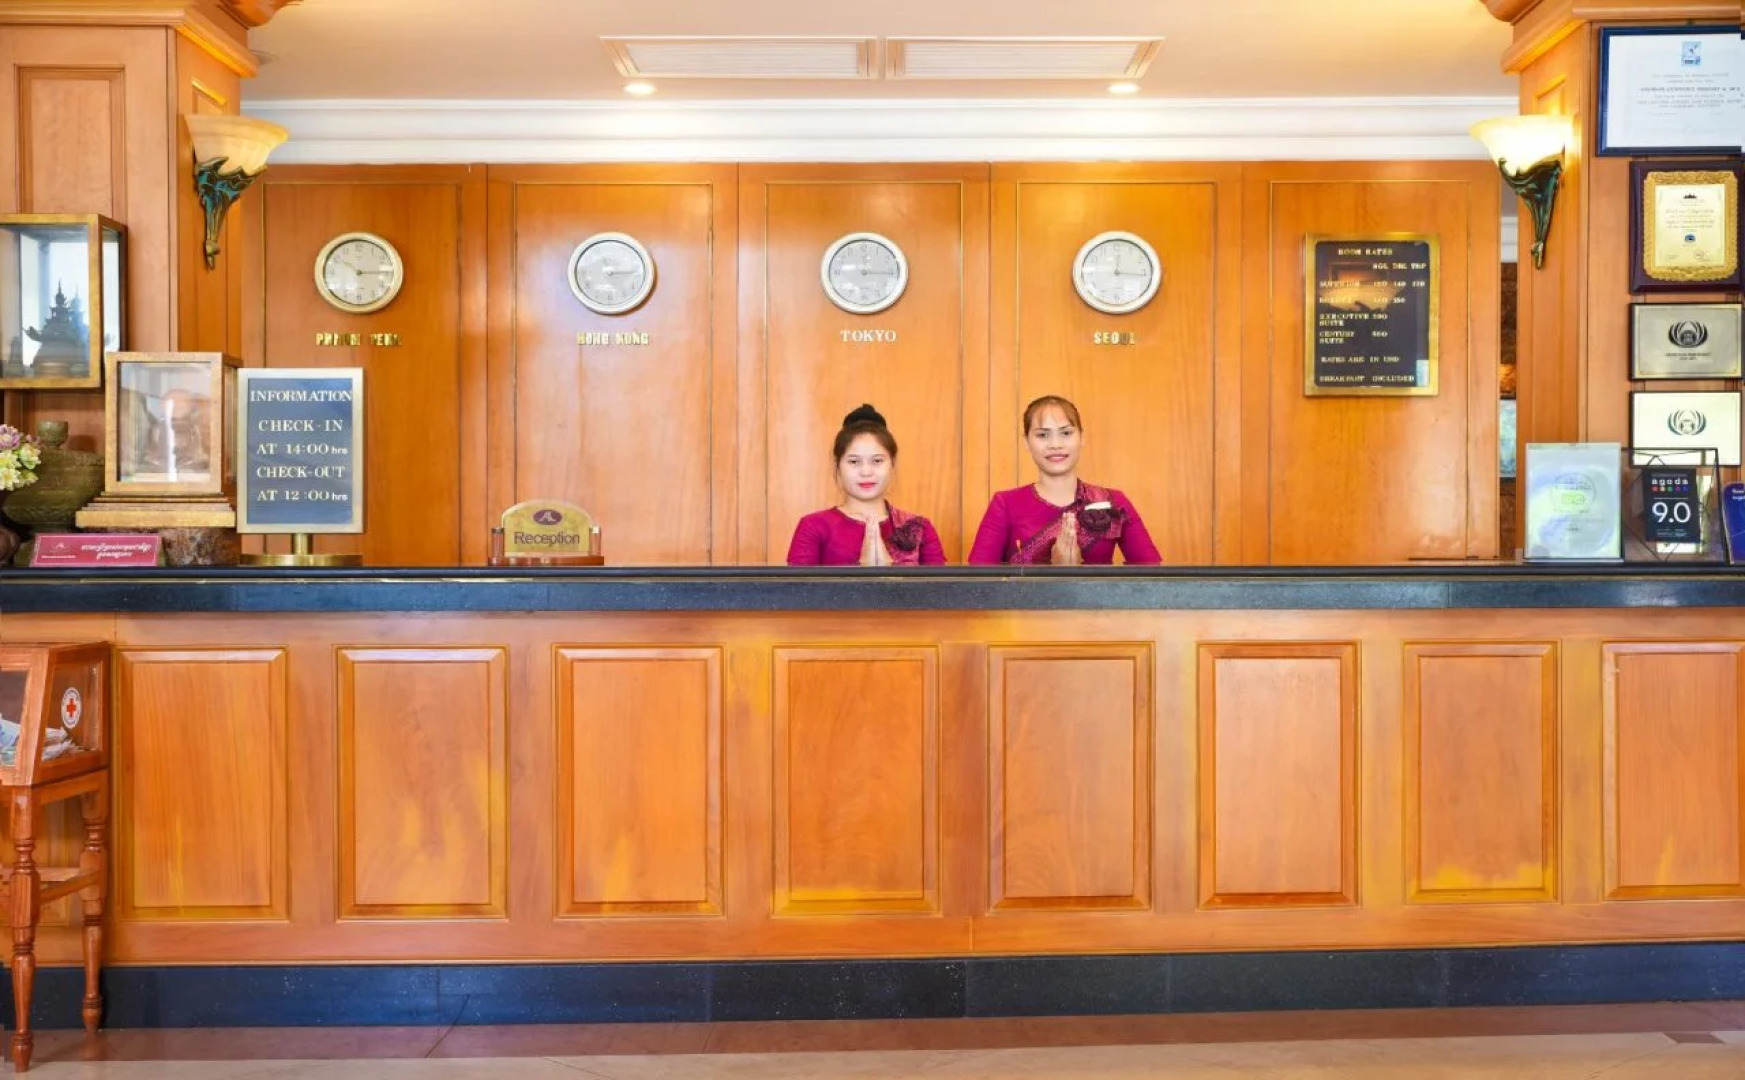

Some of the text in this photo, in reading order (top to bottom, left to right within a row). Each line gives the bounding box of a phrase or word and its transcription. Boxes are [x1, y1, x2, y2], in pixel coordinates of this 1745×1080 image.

[840, 329, 897, 342] TOKYO
[250, 390, 353, 402] INFORMATION
[257, 442, 278, 455] AT
[330, 445, 348, 455] hrs
[256, 465, 346, 478] CHECK-OUT
[1651, 478, 1689, 486] agoda
[257, 490, 278, 501] AT
[331, 491, 348, 501] hrs
[1652, 501, 1692, 523] 9.0
[513, 531, 580, 547] Reception
